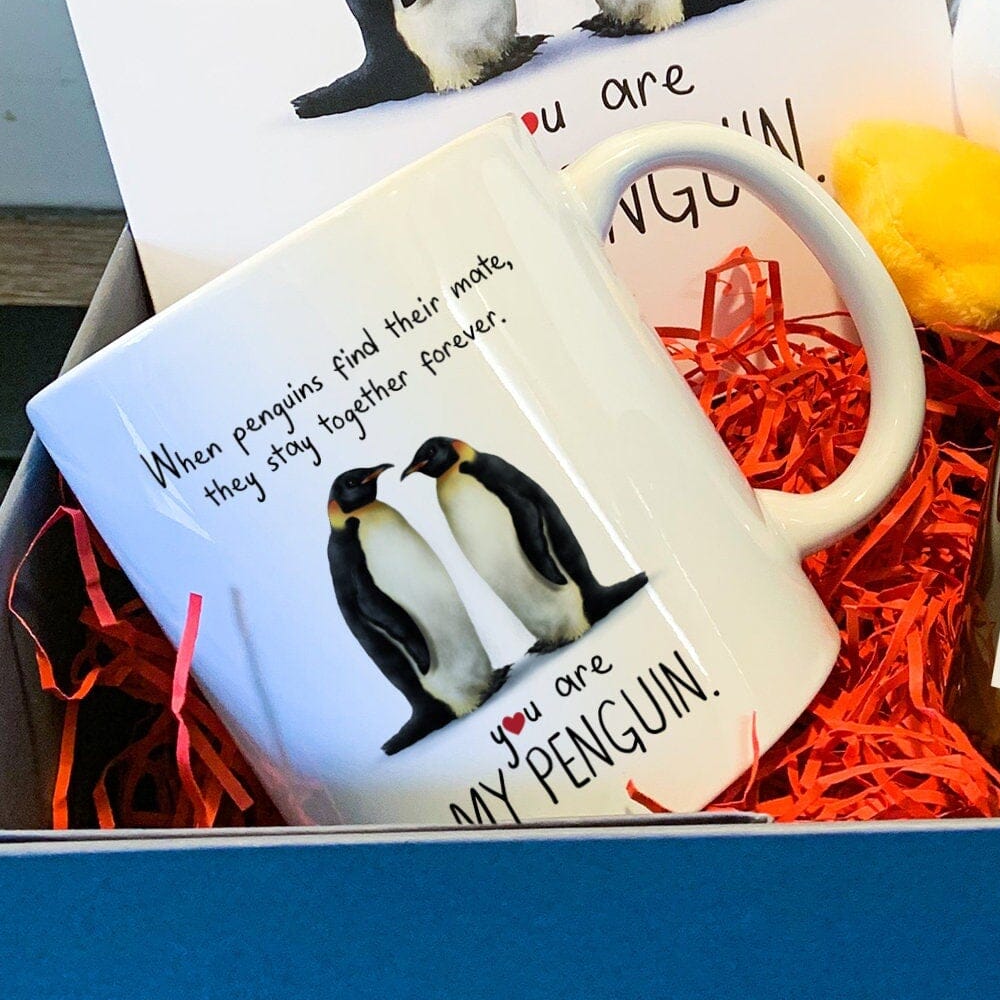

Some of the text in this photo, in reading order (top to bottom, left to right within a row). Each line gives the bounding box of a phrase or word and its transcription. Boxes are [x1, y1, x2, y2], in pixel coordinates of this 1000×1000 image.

[600, 64, 696, 110] are
[139, 254, 514, 490] When penguins find their mate,
[203, 310, 507, 507] they stay together forever.
[524, 649, 721, 806] PENGUIN.
[554, 654, 614, 698] are
